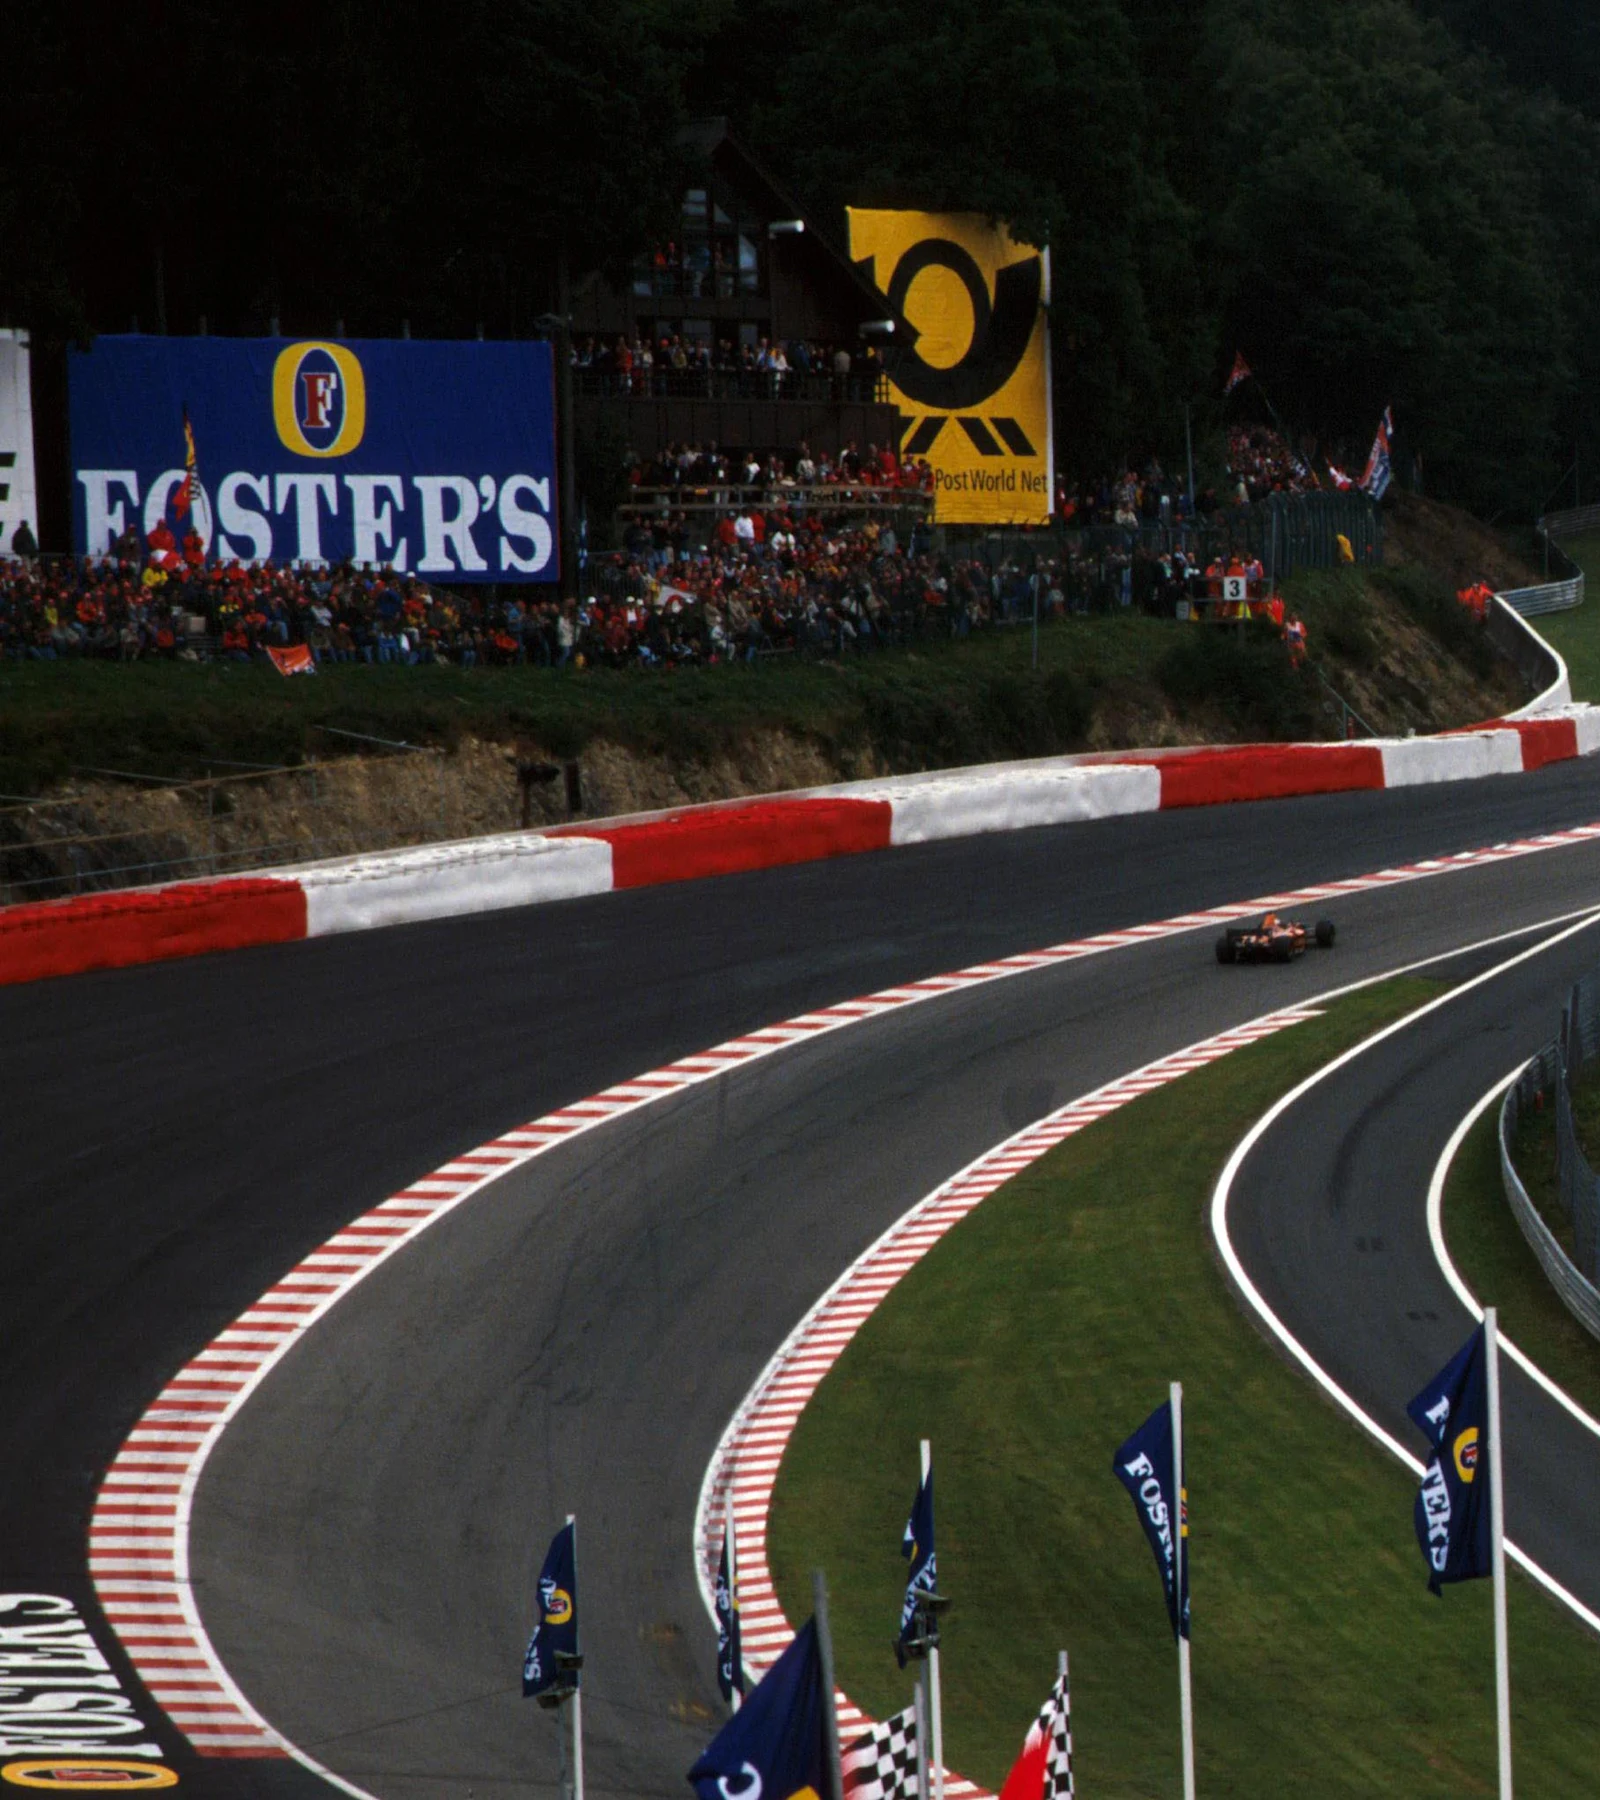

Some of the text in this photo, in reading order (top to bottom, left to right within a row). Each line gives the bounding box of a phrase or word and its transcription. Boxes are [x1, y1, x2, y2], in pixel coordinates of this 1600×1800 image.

[302, 373, 337, 428] F
[1021, 470, 1048, 493] Net
[77, 469, 553, 574] FOSTER'S
[1228, 580, 1241, 598] 3
